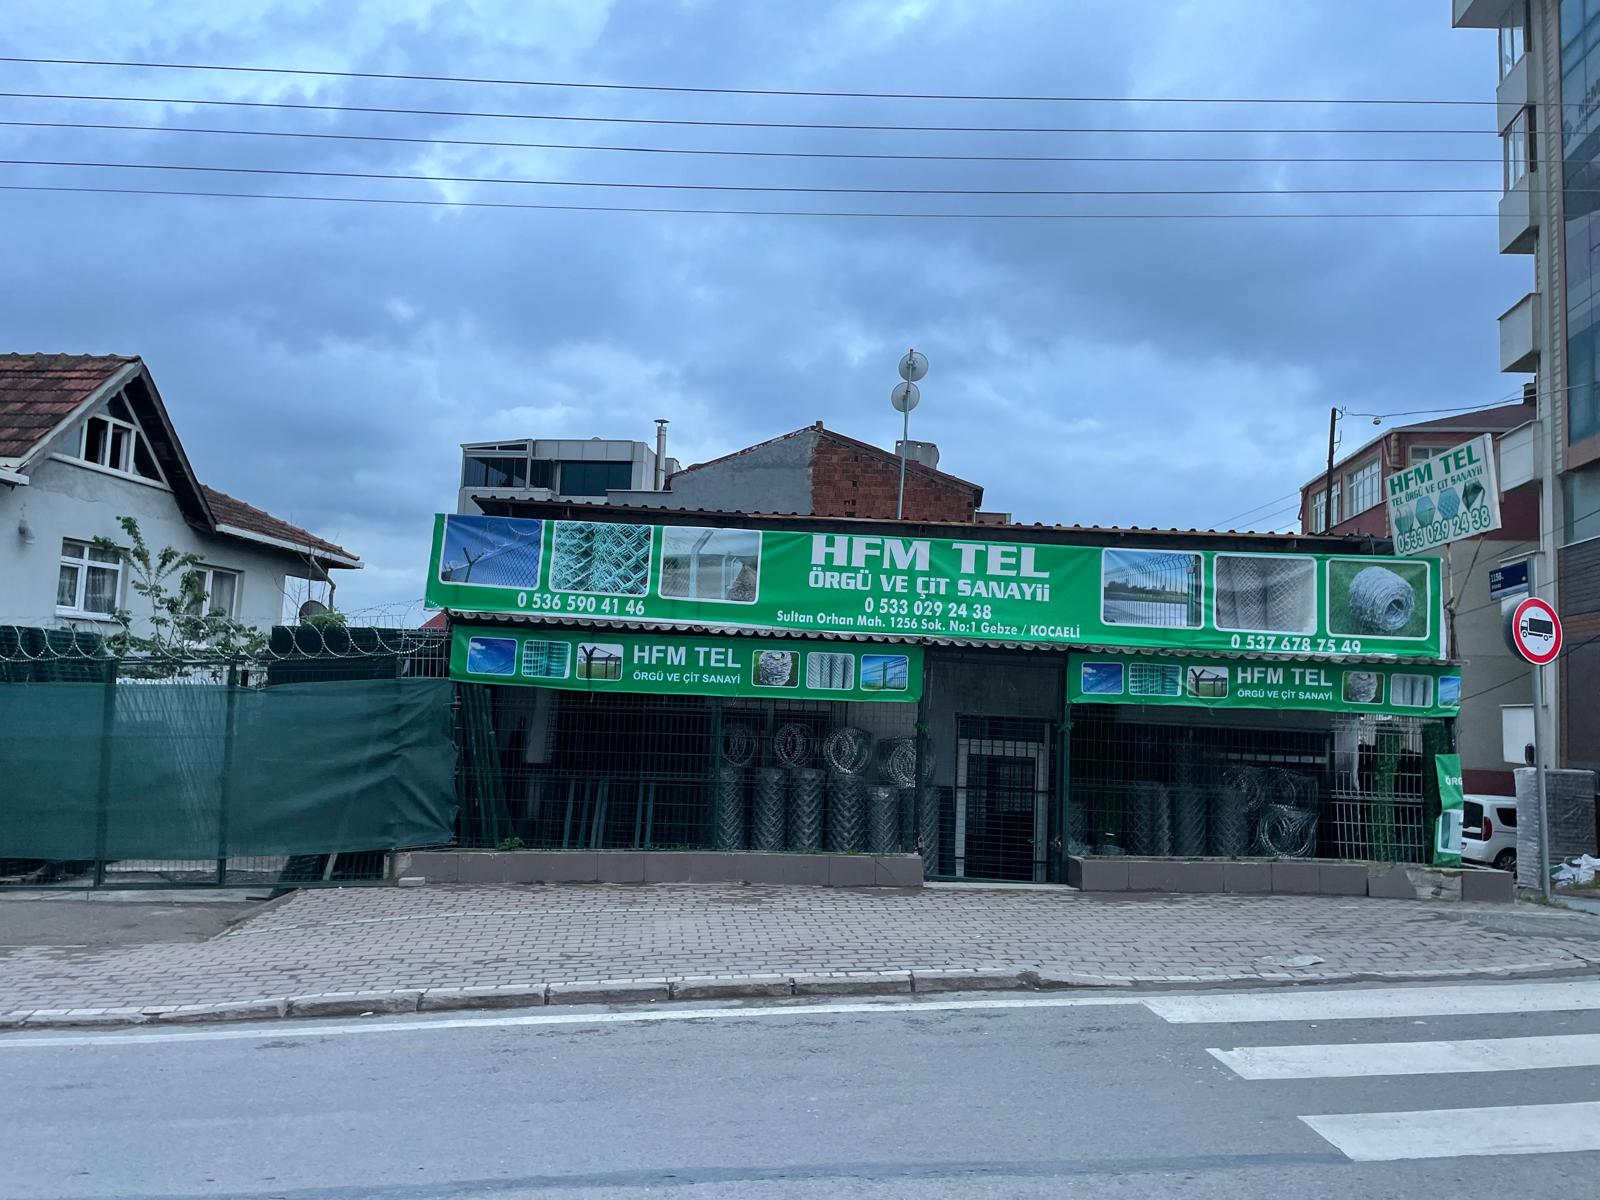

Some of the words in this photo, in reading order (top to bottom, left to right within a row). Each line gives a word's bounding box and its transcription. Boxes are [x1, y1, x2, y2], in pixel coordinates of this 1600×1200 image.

[1389, 463, 1433, 496] HFM
[1439, 444, 1481, 474] TEL
[1392, 497, 1403, 507] TEL
[1425, 483, 1436, 494] VE
[1397, 527, 1425, 553] 0533
[1426, 519, 1450, 544] 029
[1452, 512, 1469, 536] 24
[1471, 505, 1491, 530] 38
[811, 535, 931, 571] HFM
[952, 543, 1050, 578] TEL
[809, 567, 872, 591] ÖRGÜ
[879, 575, 908, 593] VE
[517, 592, 527, 608] 0
[532, 593, 561, 610] 536
[566, 595, 596, 613] 590
[601, 598, 619, 614] 41
[625, 599, 645, 616] 46
[864, 597, 874, 613] 0
[880, 598, 908, 615] 533
[914, 600, 943, 617] 029
[948, 602, 968, 618] 24
[972, 604, 992, 619] 38
[776, 610, 813, 623] Sultan
[817, 612, 854, 626] Orhan
[857, 615, 886, 628] Mah.
[890, 617, 918, 629] 1256
[921, 618, 946, 631] Sok.
[950, 620, 976, 633] No:1
[981, 622, 1018, 635] Gebze
[1021, 624, 1027, 636] /
[1231, 634, 1240, 649] 0
[1246, 635, 1276, 650] 537
[1281, 637, 1311, 651] 678
[1317, 638, 1336, 652] 75
[1341, 639, 1361, 653] 49
[633, 645, 686, 666] HFM
[694, 647, 741, 668] TEL
[633, 670, 664, 681] ÖRGÜ
[666, 673, 681, 682] VE
[683, 671, 700, 685] ÇİT
[702, 673, 741, 685] SANAYİ
[1237, 667, 1283, 684] HFM
[1291, 668, 1333, 686] TEL
[1237, 688, 1265, 698] ÖRGÜ
[1267, 690, 1279, 699] VE
[1298, 691, 1333, 701] SANAYİ
